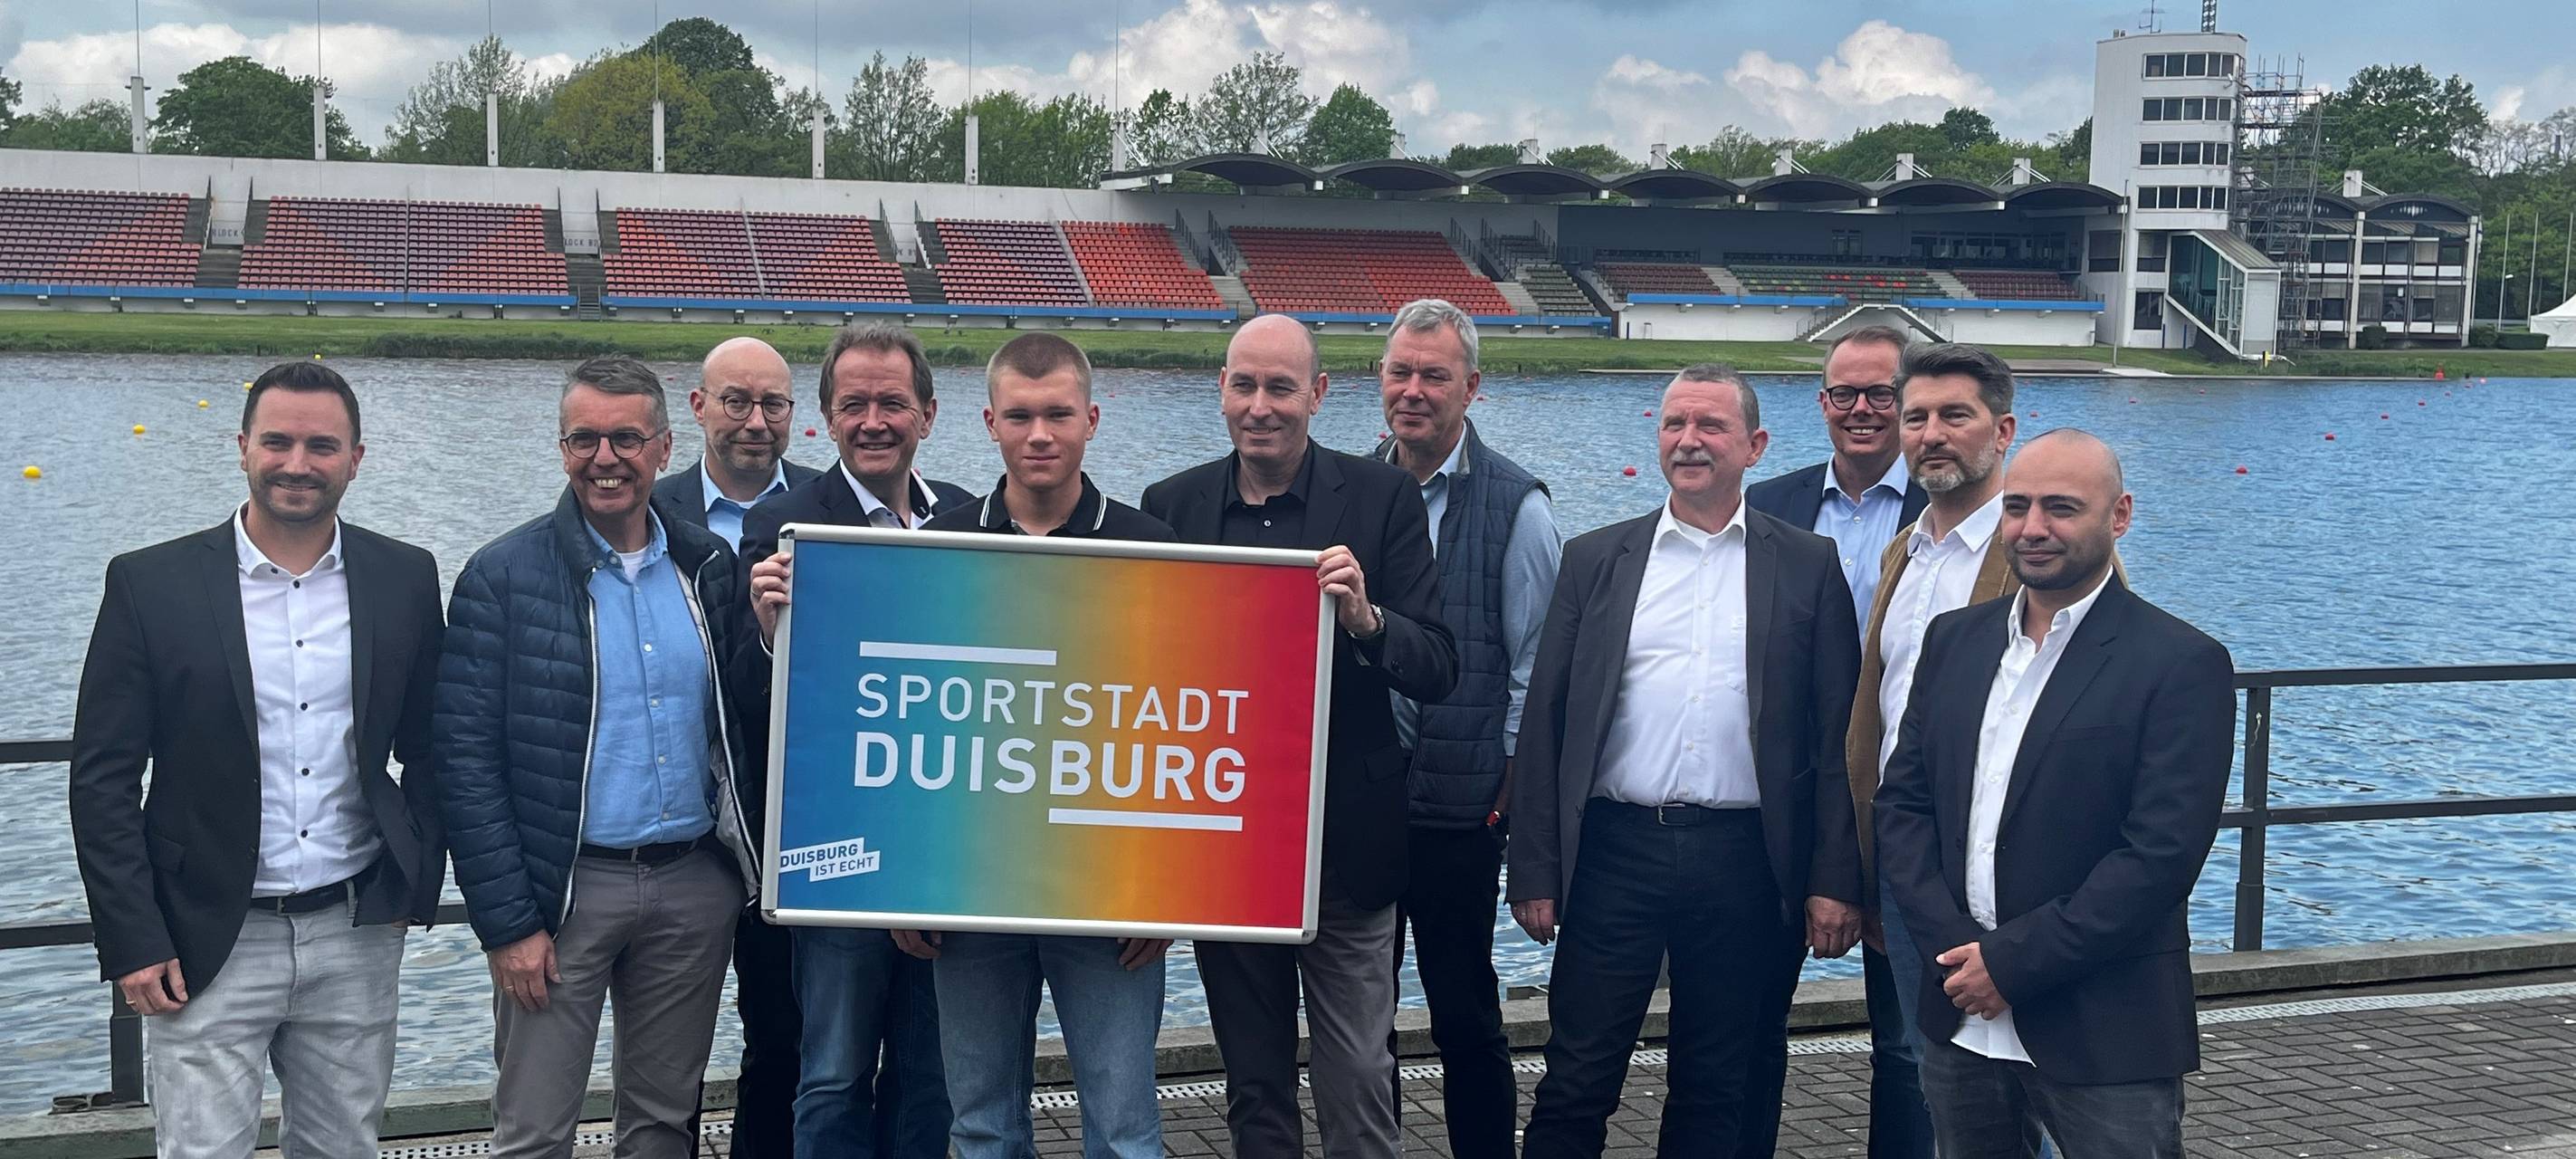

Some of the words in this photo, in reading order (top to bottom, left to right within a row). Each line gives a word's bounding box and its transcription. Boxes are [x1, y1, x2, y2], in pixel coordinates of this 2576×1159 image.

[856, 673, 1250, 734] SPORTSTADT
[854, 731, 1246, 803] DUISBURG
[780, 843, 858, 867] DUISBURG
[816, 863, 835, 876] IST
[839, 856, 874, 872] ECHT
